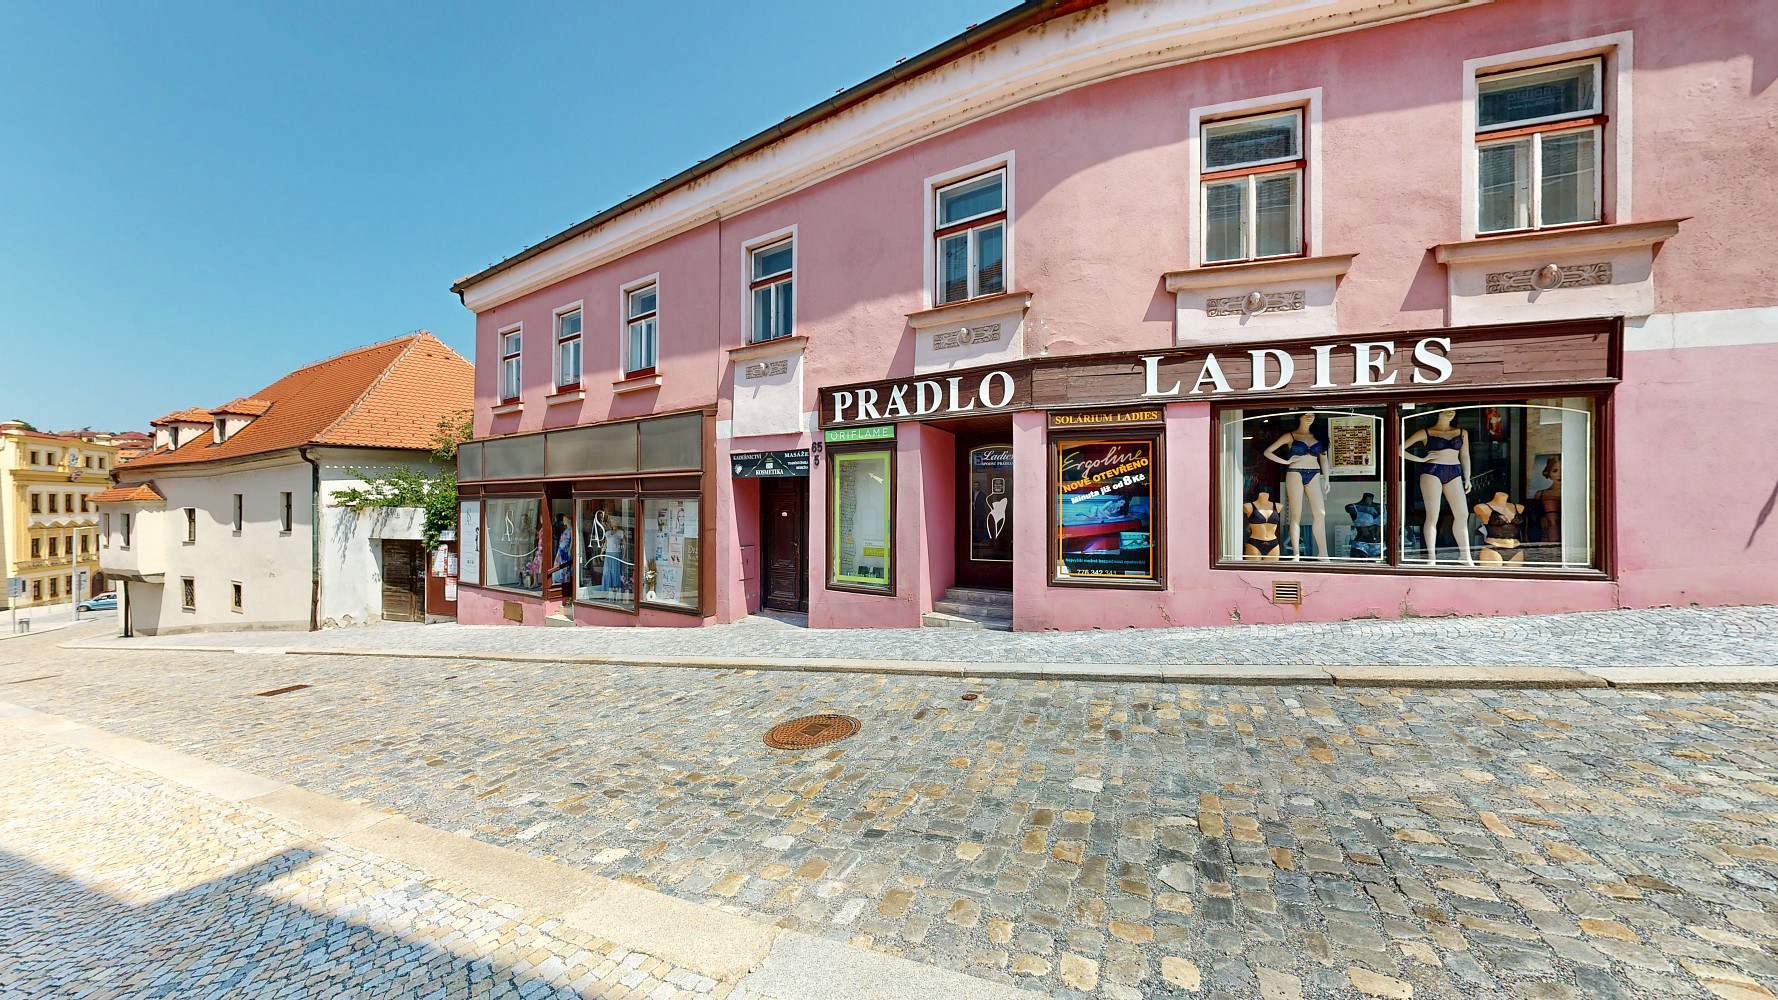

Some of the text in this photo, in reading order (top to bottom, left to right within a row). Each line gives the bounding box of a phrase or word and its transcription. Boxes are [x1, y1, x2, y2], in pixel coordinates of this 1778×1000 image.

[1141, 337, 1453, 397] LADIES
[832, 371, 1015, 422] PRÁDLO
[1055, 411, 1158, 425] SOLÁRIUM LADIES
[830, 427, 889, 441] ORIFLAME
[811, 441, 823, 453] 65
[814, 454, 820, 466] 5
[1060, 446, 1144, 478] Ergoline
[1092, 458, 1149, 483] OTEVŘENO
[1070, 489, 1100, 505] Minuta
[1112, 480, 1124, 490] od
